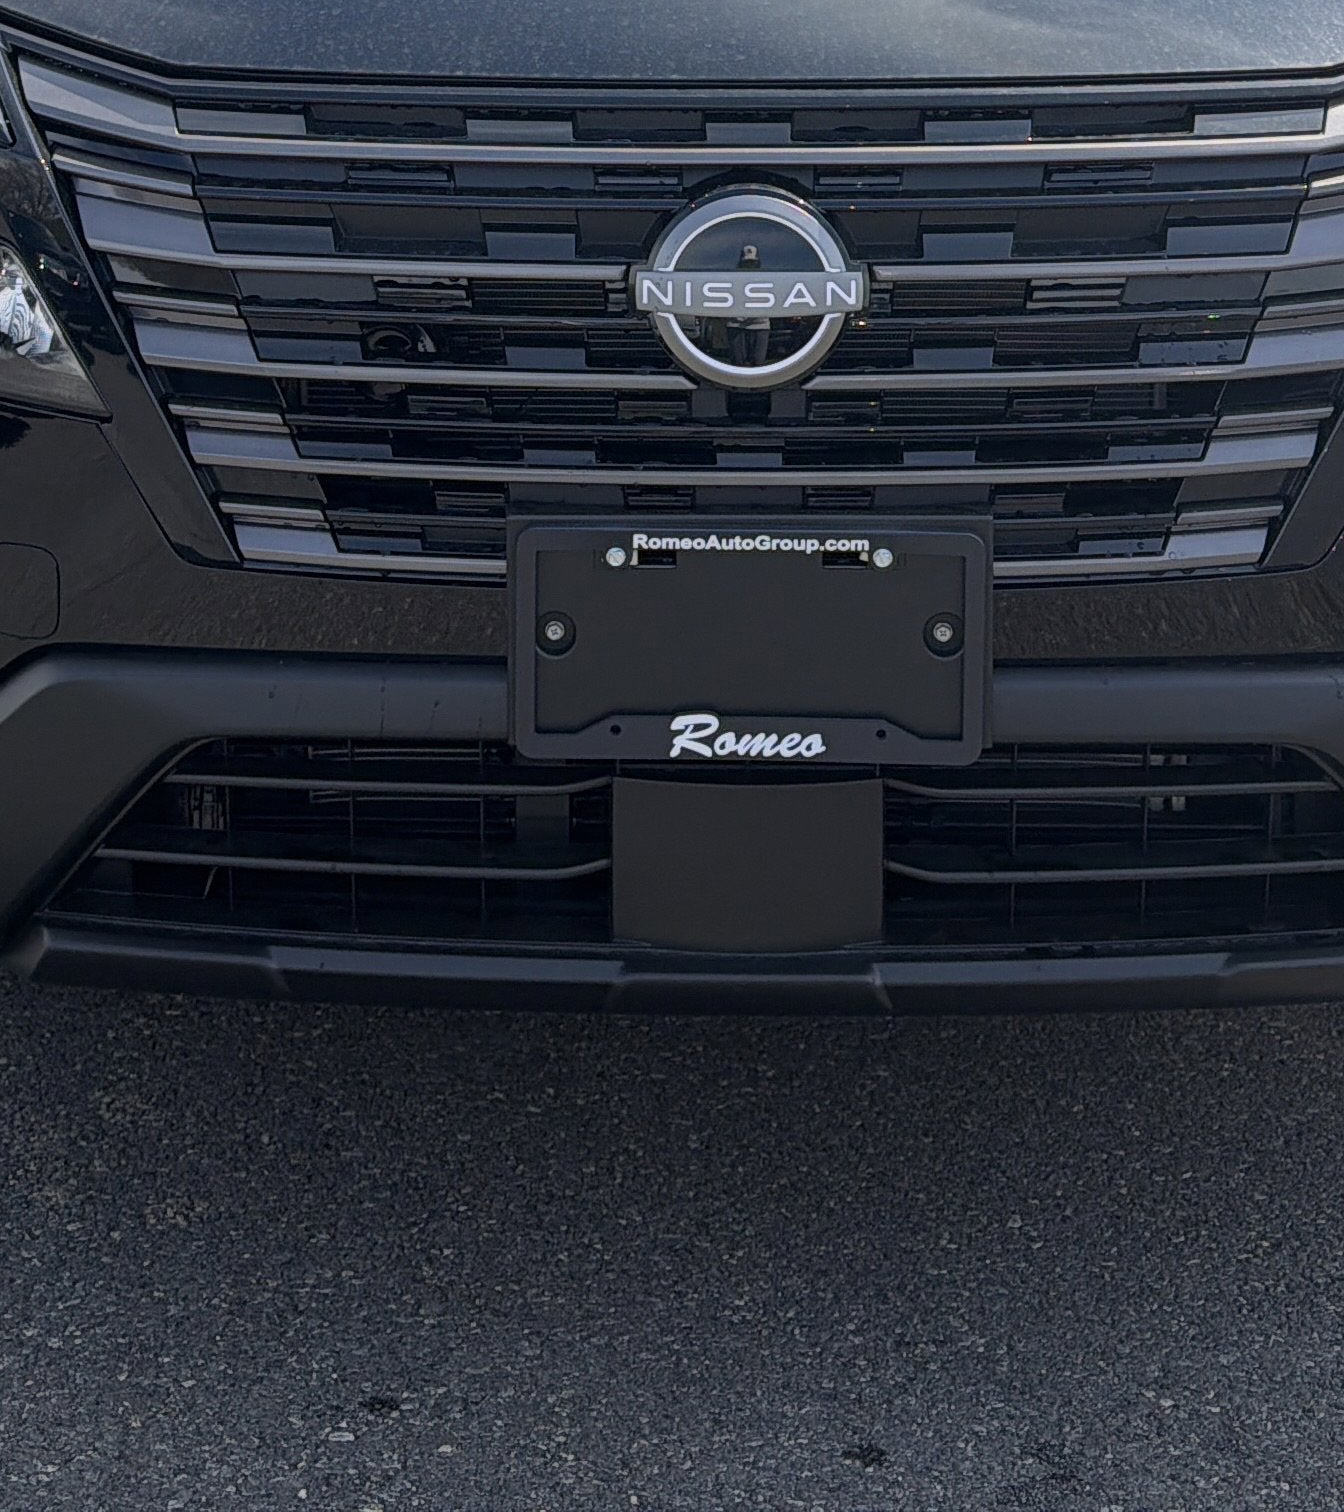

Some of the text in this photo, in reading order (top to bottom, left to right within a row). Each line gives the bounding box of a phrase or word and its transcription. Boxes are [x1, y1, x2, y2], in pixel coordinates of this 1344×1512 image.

[642, 279, 857, 308] NISSAN
[632, 533, 870, 555] RomeoAutoGroup.com
[669, 713, 827, 758] Romeo
